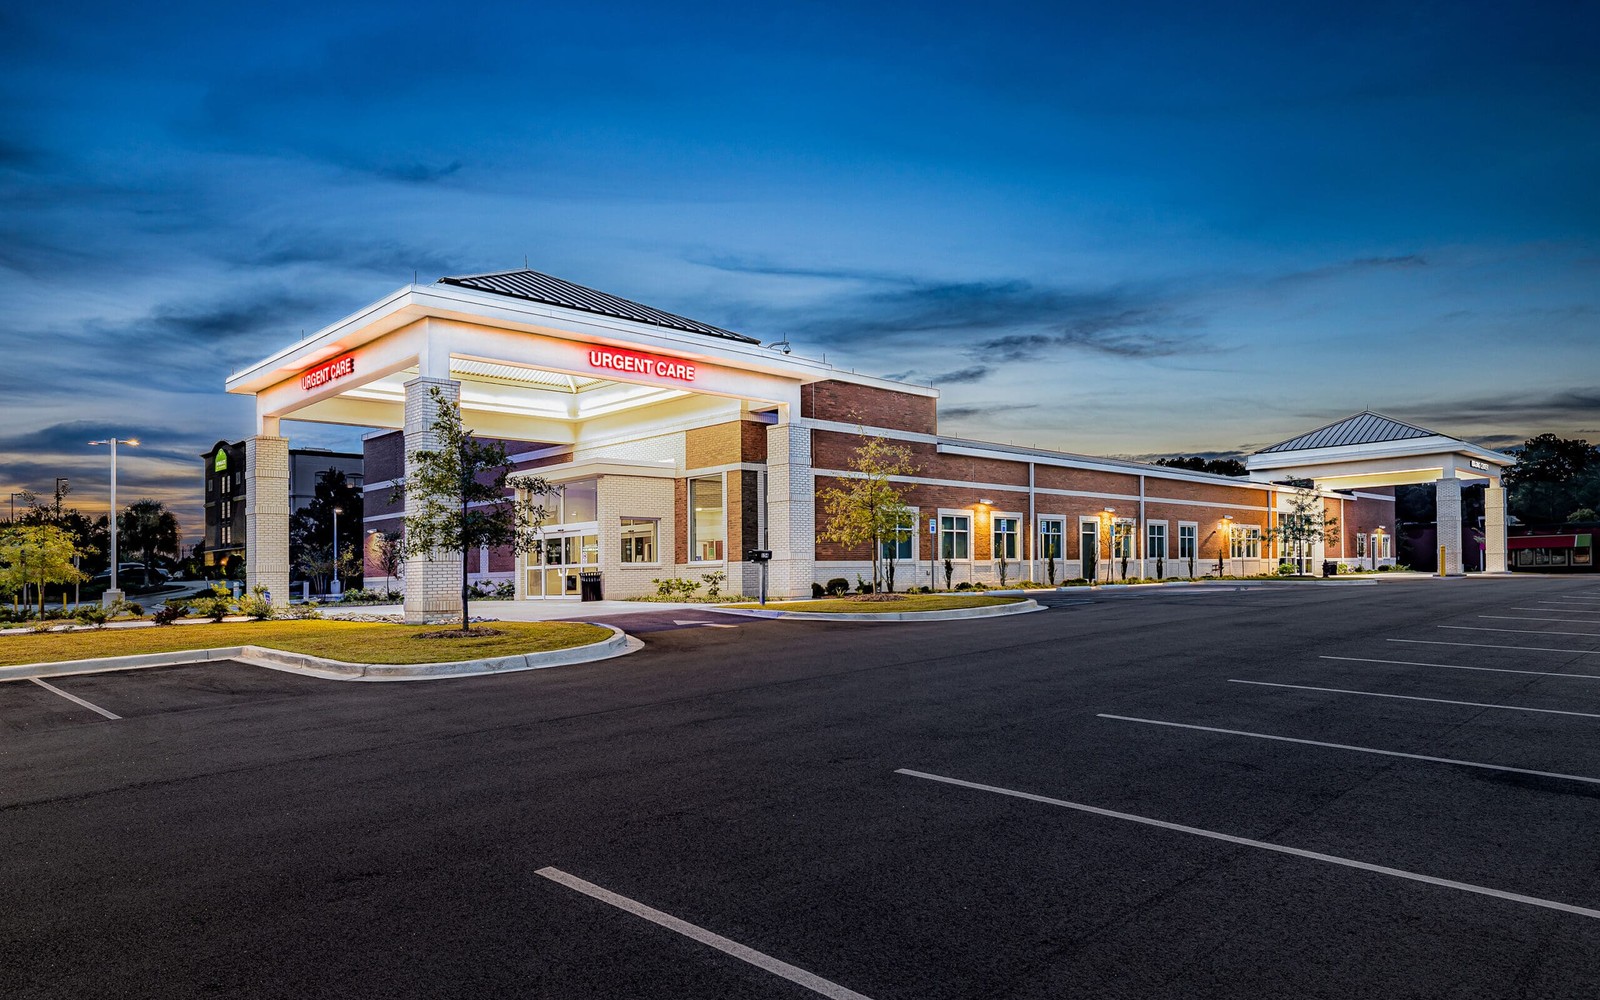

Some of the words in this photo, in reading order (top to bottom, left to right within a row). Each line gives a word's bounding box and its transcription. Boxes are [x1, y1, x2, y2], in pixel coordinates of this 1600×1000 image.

[302, 367, 330, 389] URGENT
[330, 358, 352, 378] CARE
[590, 350, 653, 374] URGENT
[655, 361, 695, 381] CARE
